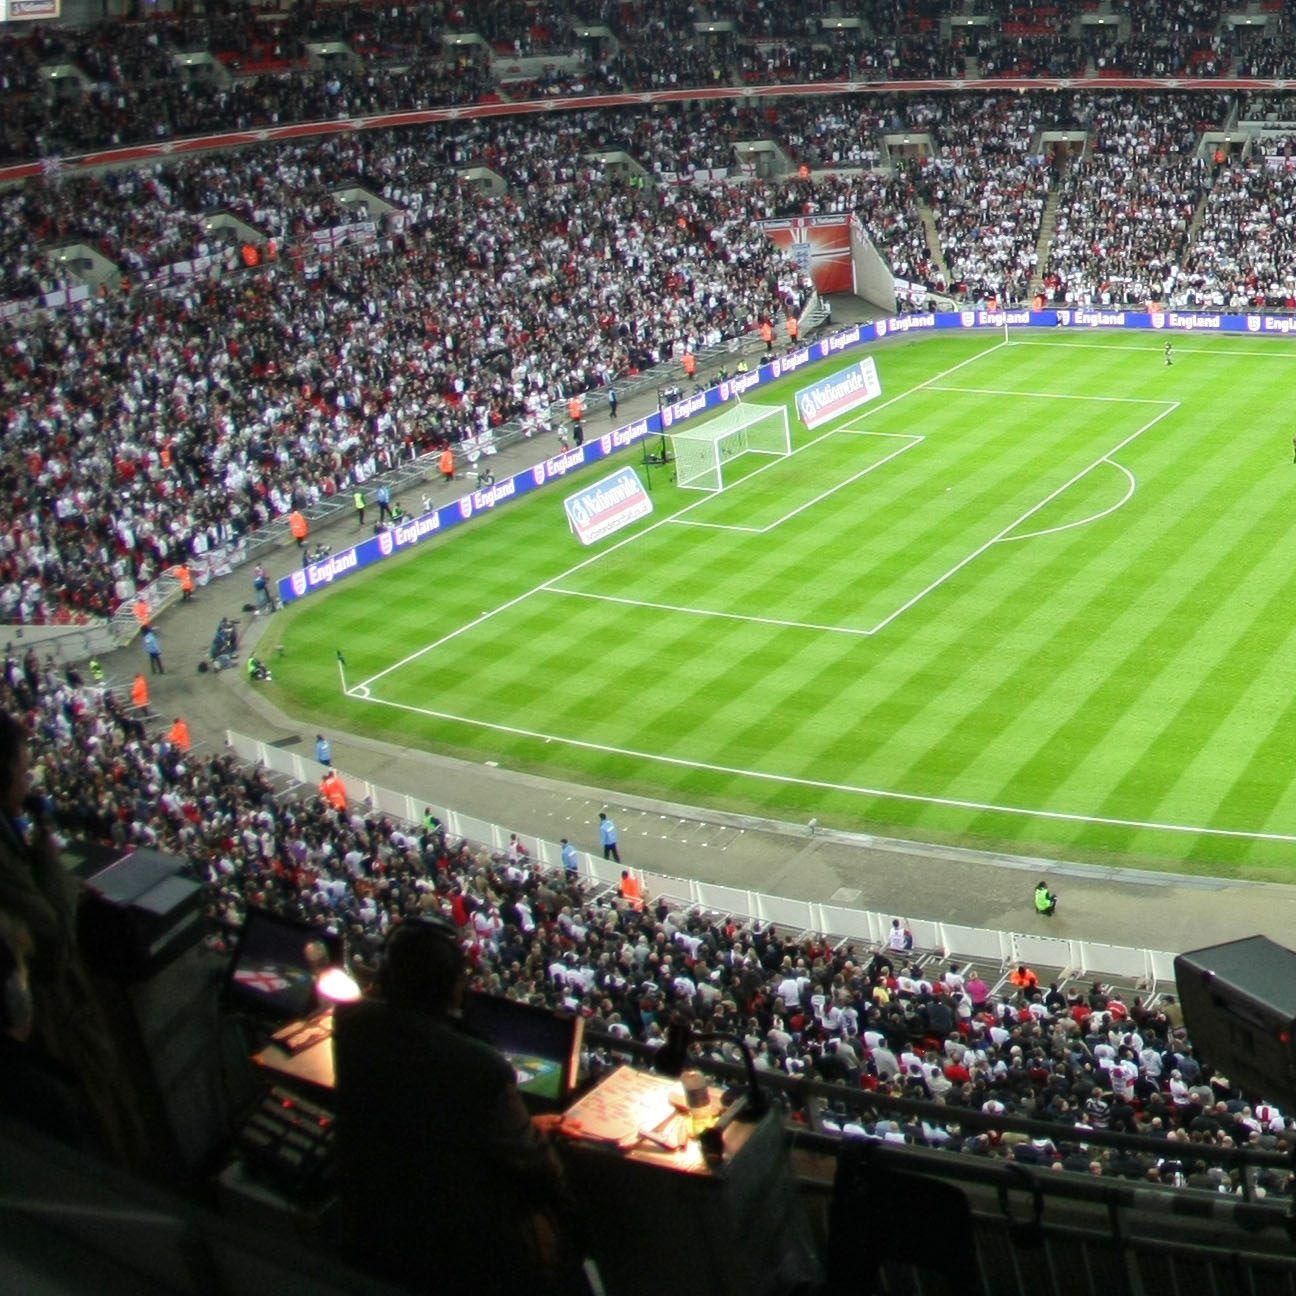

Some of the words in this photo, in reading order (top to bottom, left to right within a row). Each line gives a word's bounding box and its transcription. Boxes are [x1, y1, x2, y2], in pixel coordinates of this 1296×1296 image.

[889, 315, 934, 332] England
[979, 311, 1029, 327] England
[1074, 311, 1125, 328] England
[1169, 314, 1220, 330] England
[829, 327, 860, 349] England
[779, 349, 809, 372] England
[730, 370, 760, 394] England
[810, 371, 864, 410] Nationwide
[671, 394, 706, 419] England
[611, 420, 648, 446] England
[546, 448, 584, 477] England
[474, 478, 515, 509] England
[581, 475, 640, 517] Nationwide
[395, 511, 440, 547] England
[309, 549, 357, 585] England
